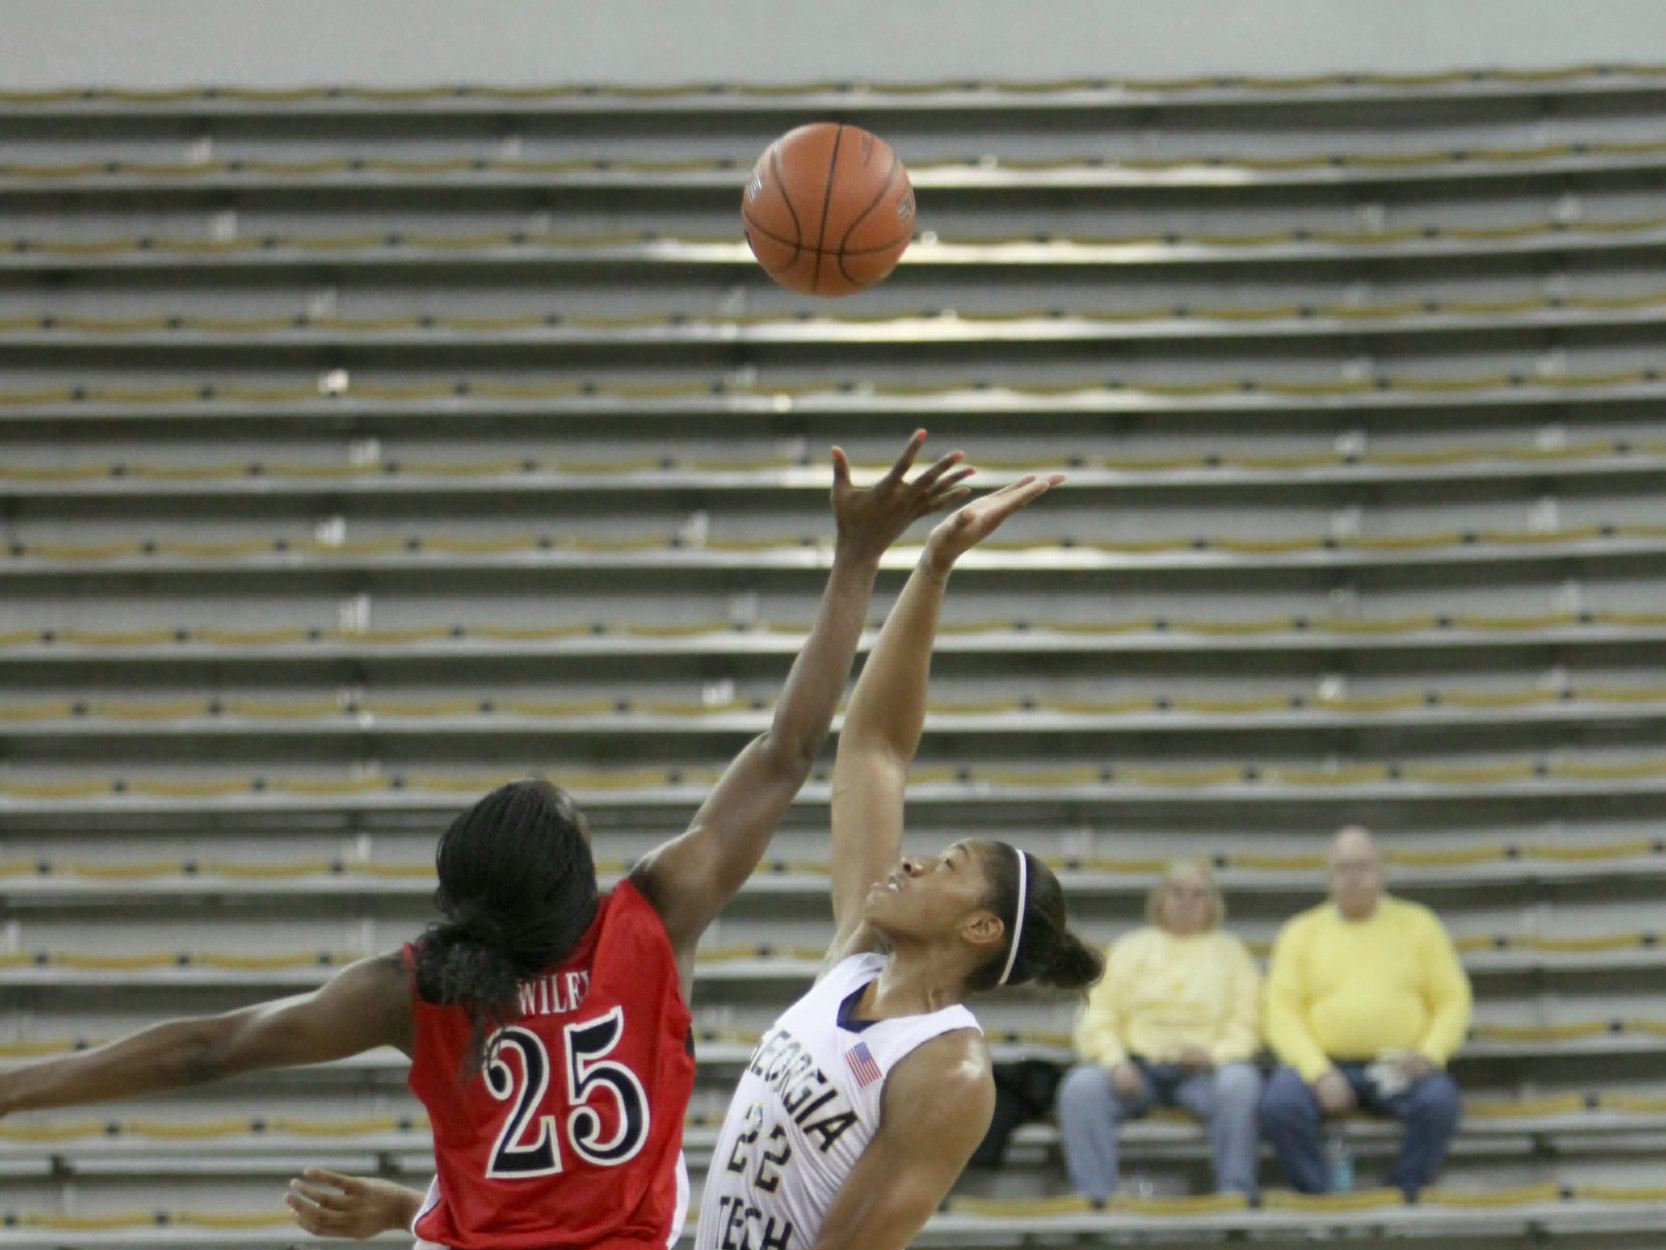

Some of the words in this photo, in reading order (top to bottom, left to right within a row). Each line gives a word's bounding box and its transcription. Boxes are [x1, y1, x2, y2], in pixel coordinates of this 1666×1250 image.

[482, 1005, 650, 1179] 25
[726, 1101, 793, 1194] 22
[749, 1029, 859, 1154] EORGIA
